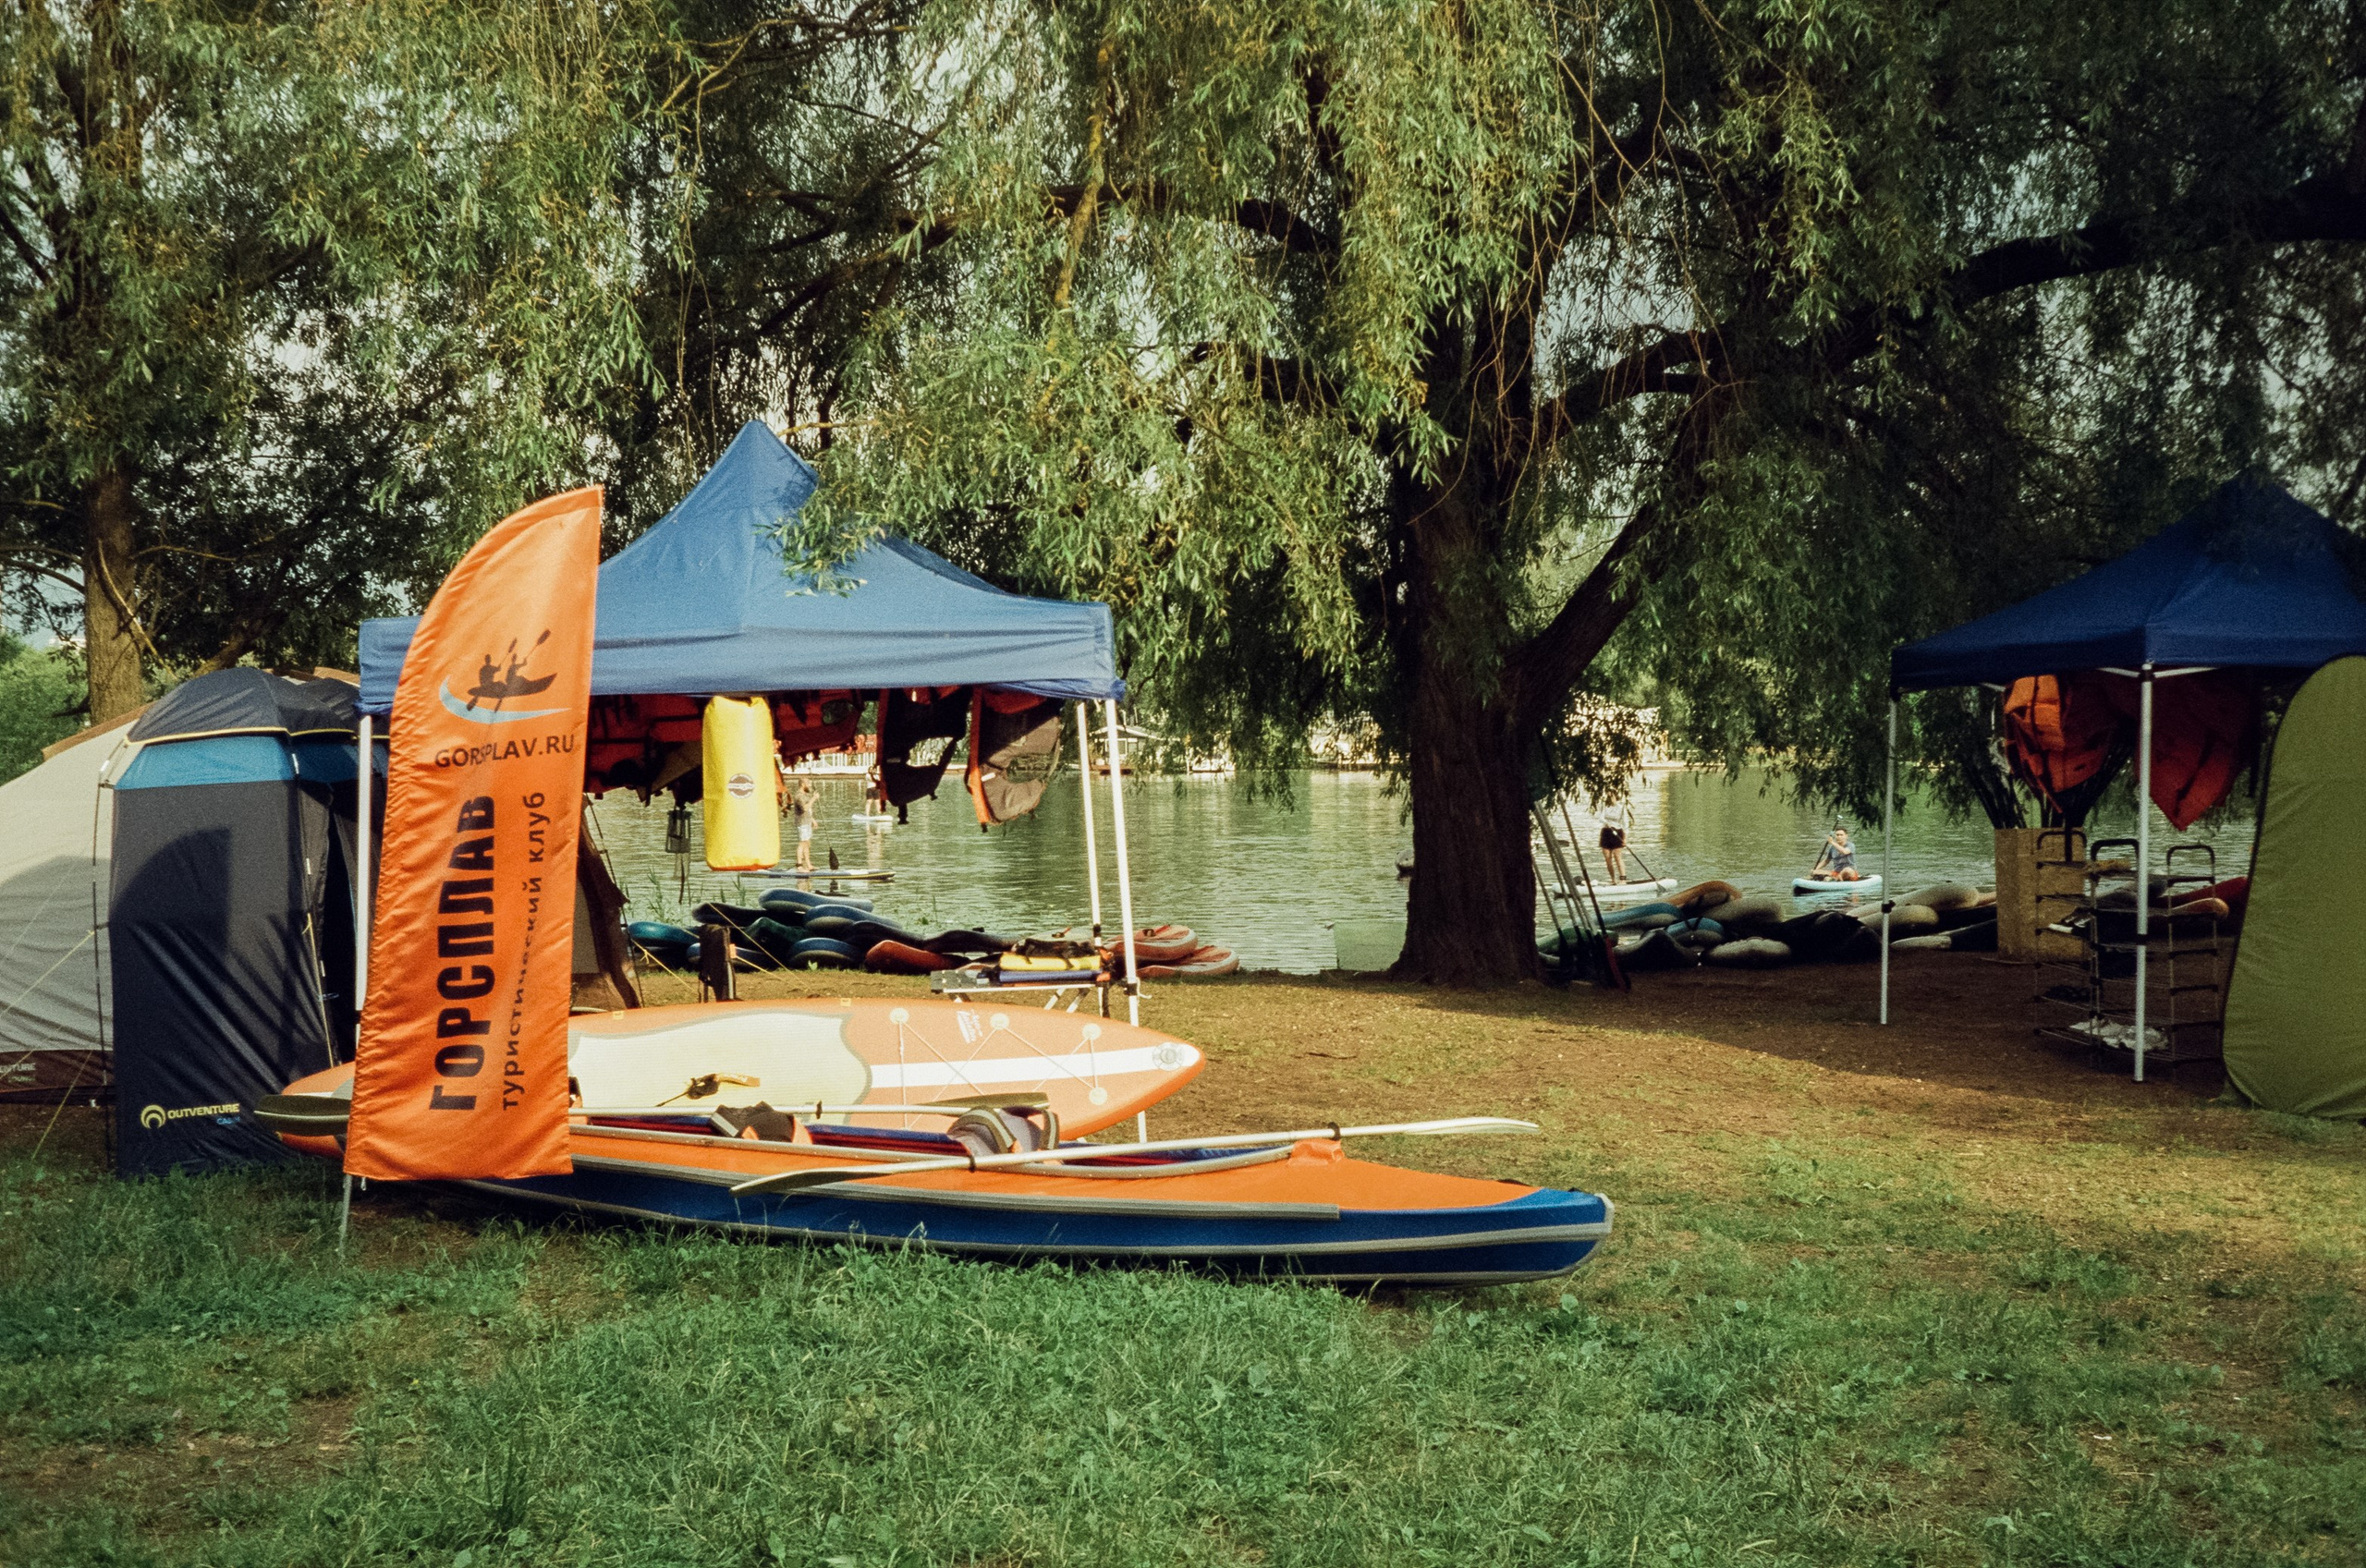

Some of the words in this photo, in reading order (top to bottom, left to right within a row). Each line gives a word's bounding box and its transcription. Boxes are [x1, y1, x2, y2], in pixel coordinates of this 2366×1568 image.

[435, 735, 574, 768] GORSPLAV.RU
[523, 793, 551, 863] клуб
[429, 796, 495, 1110] ГОРСПЛАВ
[167, 1103, 240, 1119] OUTVENTURE
